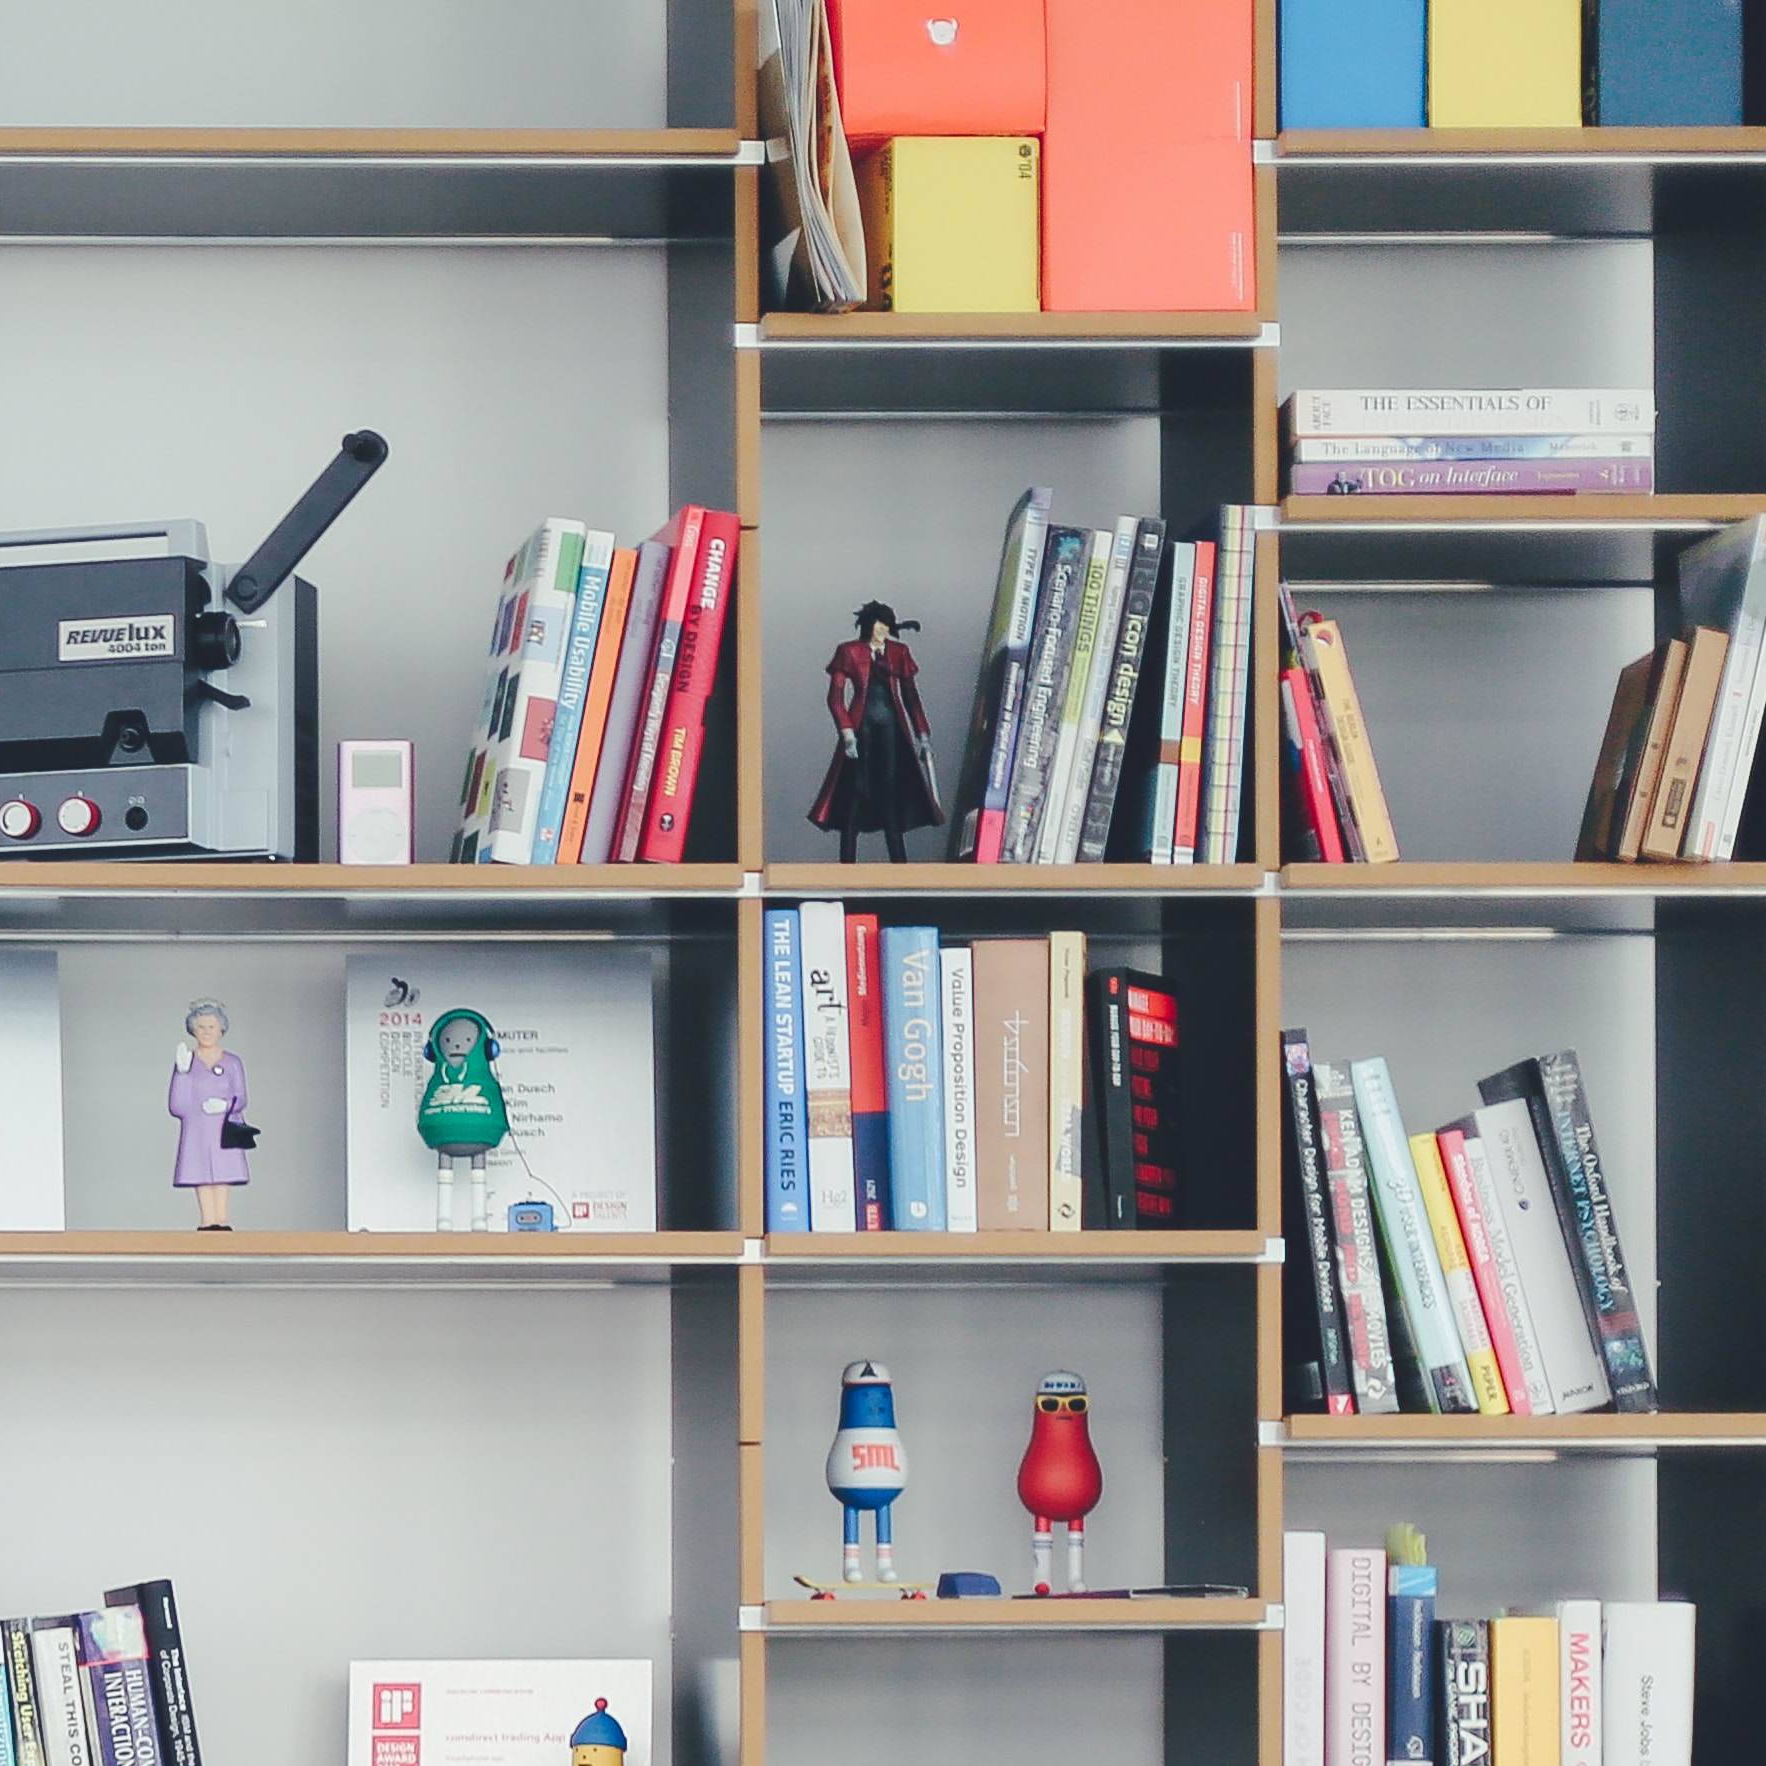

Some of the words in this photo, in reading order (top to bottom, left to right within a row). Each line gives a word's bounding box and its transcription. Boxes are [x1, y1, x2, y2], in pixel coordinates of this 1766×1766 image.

[1360, 396, 1399, 410] THE
[1406, 396, 1520, 410] ESSENTIALS
[1525, 395, 1552, 410] OF
[1361, 467, 1416, 488] TOG
[1419, 471, 1439, 484] on
[1446, 465, 1518, 487] Interface
[701, 538, 726, 610] CHANGE
[574, 576, 602, 633] Mobile
[560, 636, 589, 710] Usability
[773, 919, 791, 957] THE
[774, 960, 791, 1008] LEAN
[902, 948, 932, 1008] Van
[950, 967, 966, 1018] Value
[776, 1013, 793, 1095] STARTUP
[898, 1018, 934, 1102] Gogh
[949, 1023, 967, 1124] Proposition
[777, 1101, 794, 1144] ERIC
[780, 1149, 796, 1192] RIES
[952, 1129, 969, 1189] Design
[1351, 1557, 1371, 1647] DIGITAL
[58, 1641, 73, 1694] STEAL
[1351, 1662, 1371, 1686] BY
[1569, 1632, 1590, 1749] MAKERS
[64, 1699, 79, 1738] THIS
[1639, 1675, 1653, 1717] Steve
[1639, 1721, 1653, 1756] Jobs
